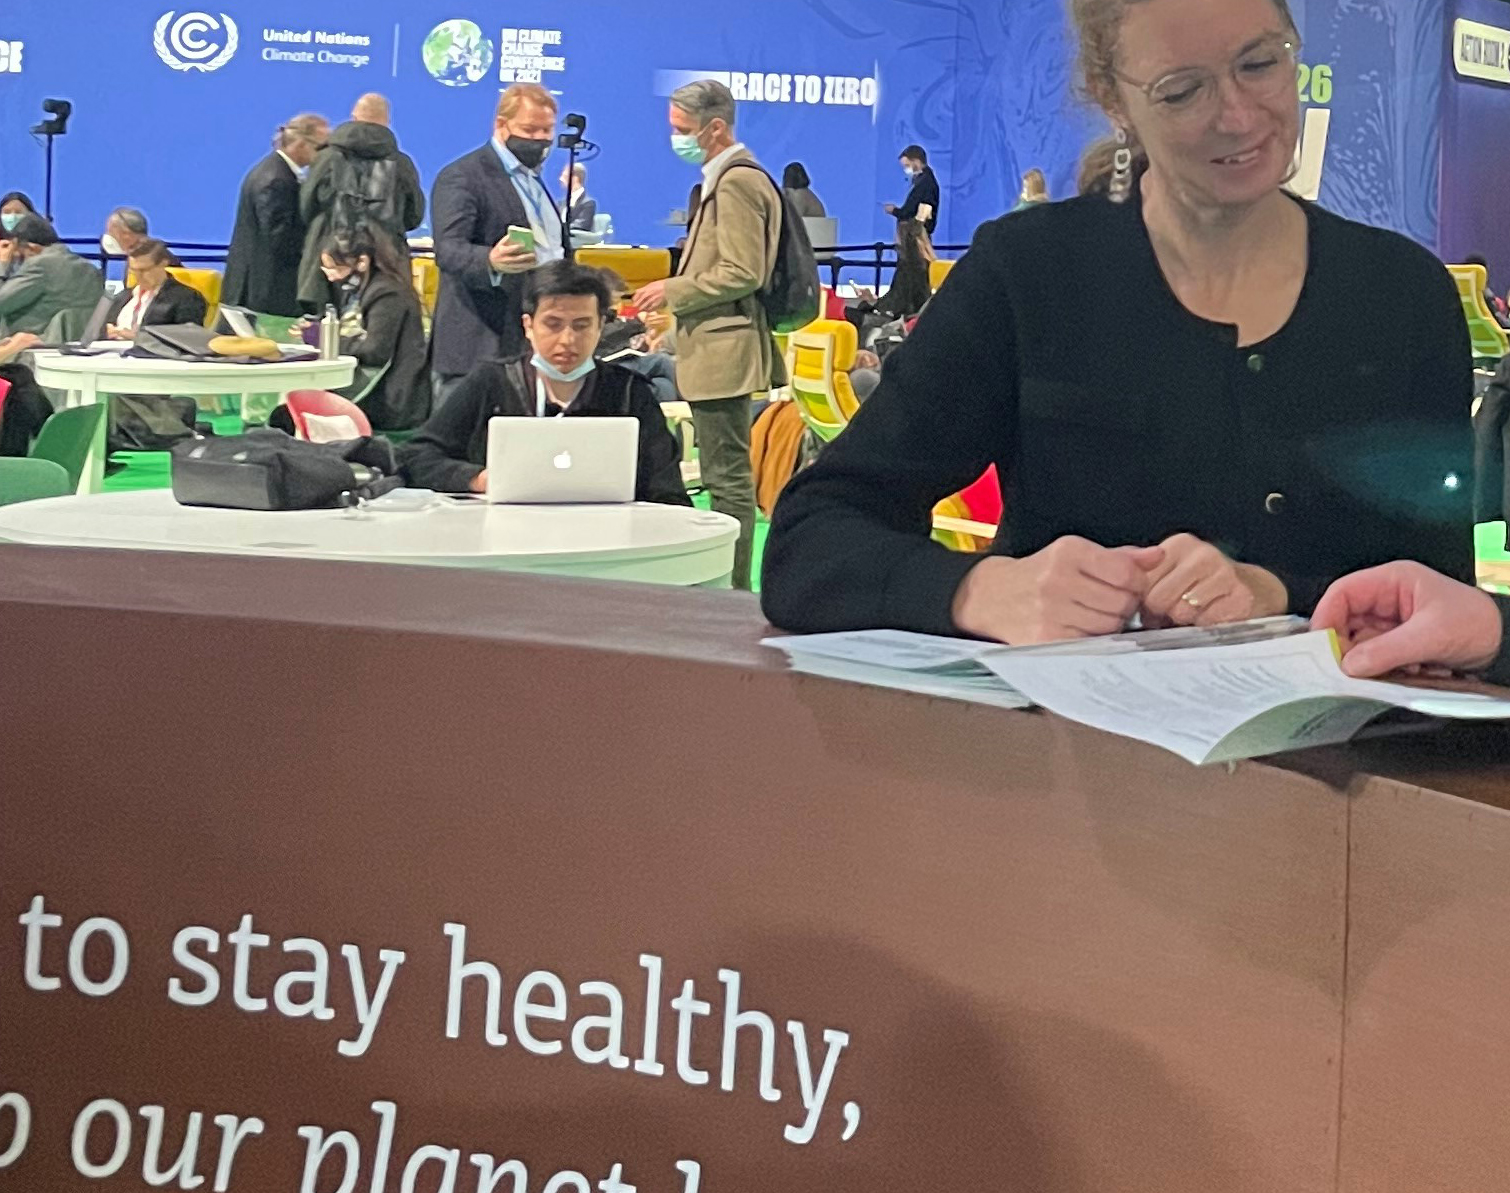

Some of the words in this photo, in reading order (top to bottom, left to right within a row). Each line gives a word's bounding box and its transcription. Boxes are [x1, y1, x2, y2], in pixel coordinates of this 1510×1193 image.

[263, 29, 311, 43] United
[315, 31, 370, 46] Nations
[262, 47, 314, 62] Climate
[317, 50, 370, 67] Change
[730, 72, 792, 103] RACE
[794, 74, 822, 104] TO
[823, 76, 877, 106] ZERO
[19, 895, 130, 996] to
[167, 913, 405, 1057] stay
[443, 922, 861, 1144] healthy,
[71, 1098, 265, 1193] our
